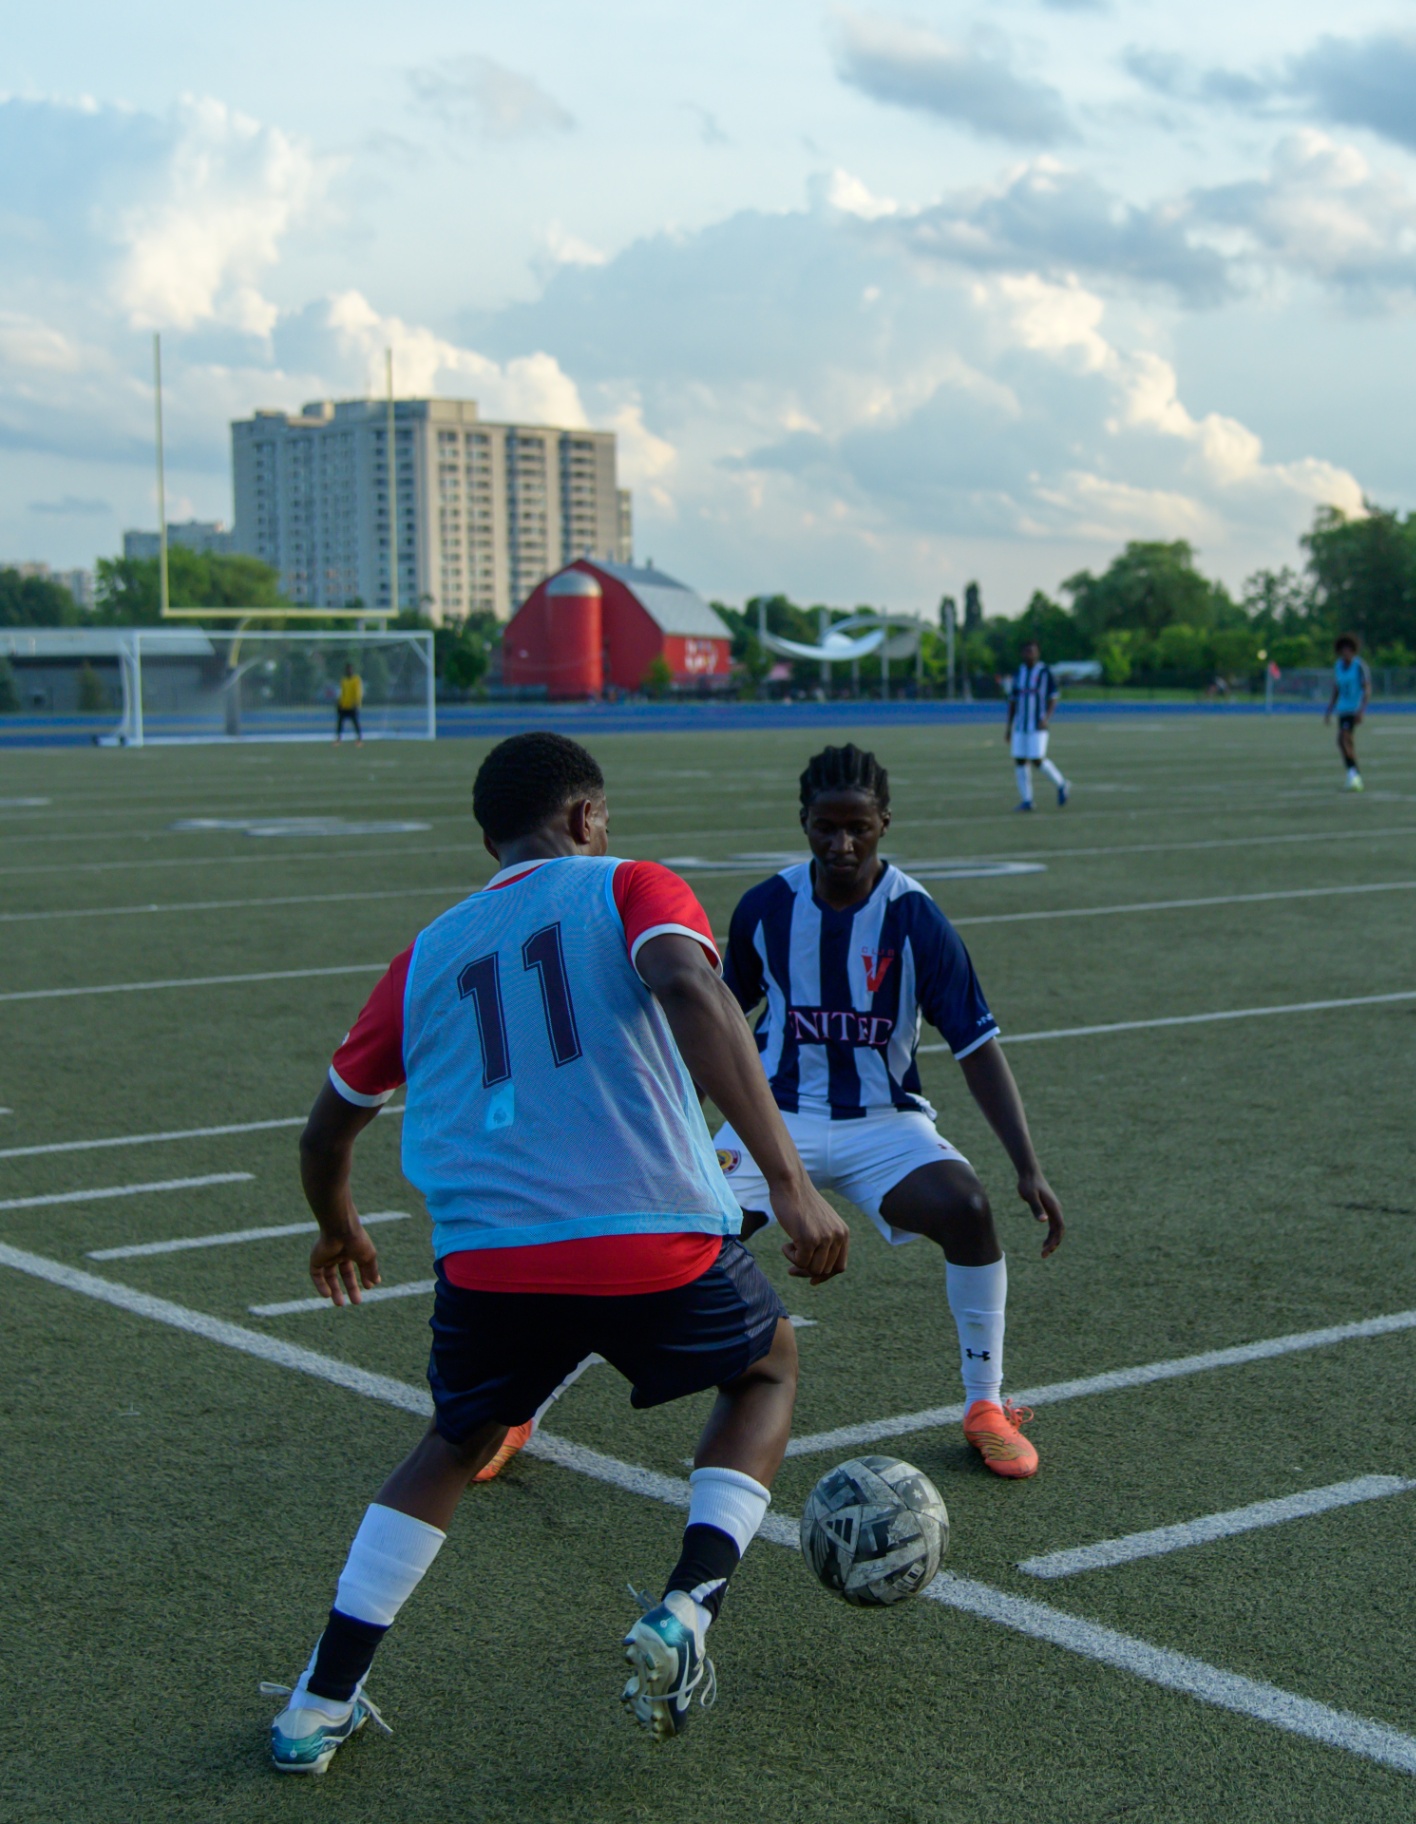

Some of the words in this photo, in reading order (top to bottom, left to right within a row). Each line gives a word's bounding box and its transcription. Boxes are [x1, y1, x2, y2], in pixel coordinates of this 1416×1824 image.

[861, 946, 895, 956] CLUB
[457, 921, 583, 1089] 11
[788, 1011, 893, 1045] NITED
